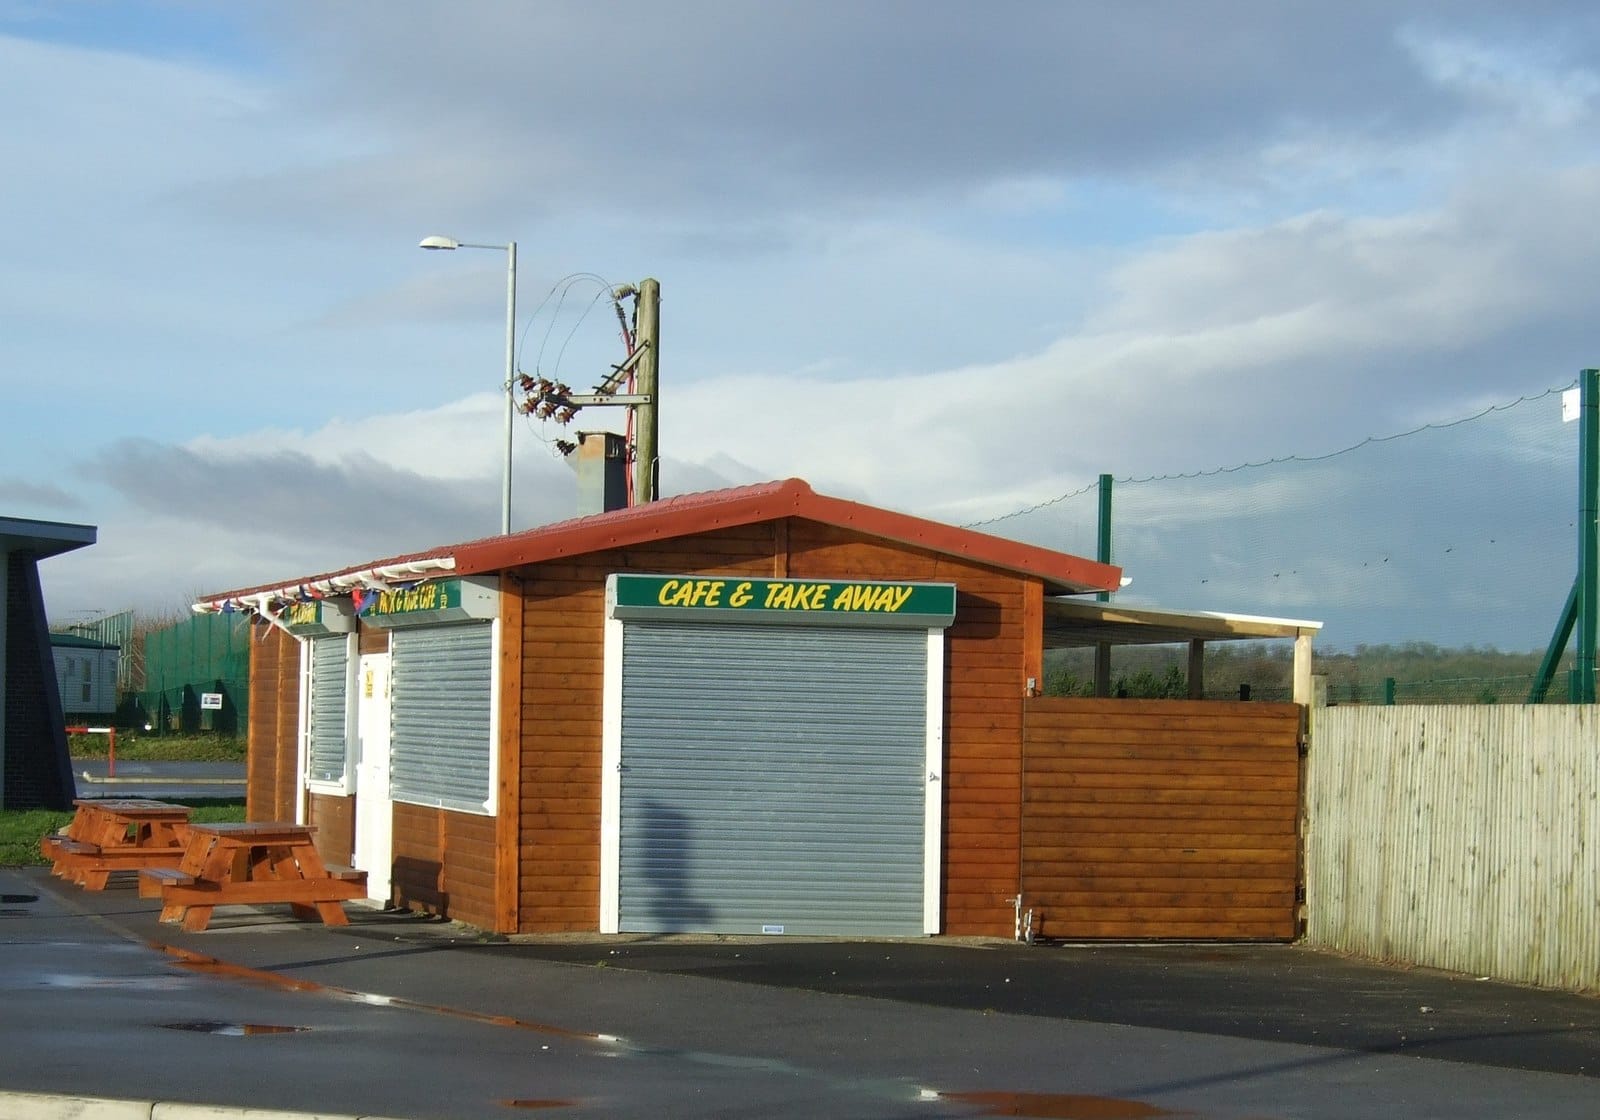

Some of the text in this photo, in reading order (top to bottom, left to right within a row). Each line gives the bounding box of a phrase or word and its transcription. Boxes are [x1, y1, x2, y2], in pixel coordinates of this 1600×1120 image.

[420, 584, 436, 609] CAFE
[658, 579, 913, 612] CAFE & TAKE AWAY
